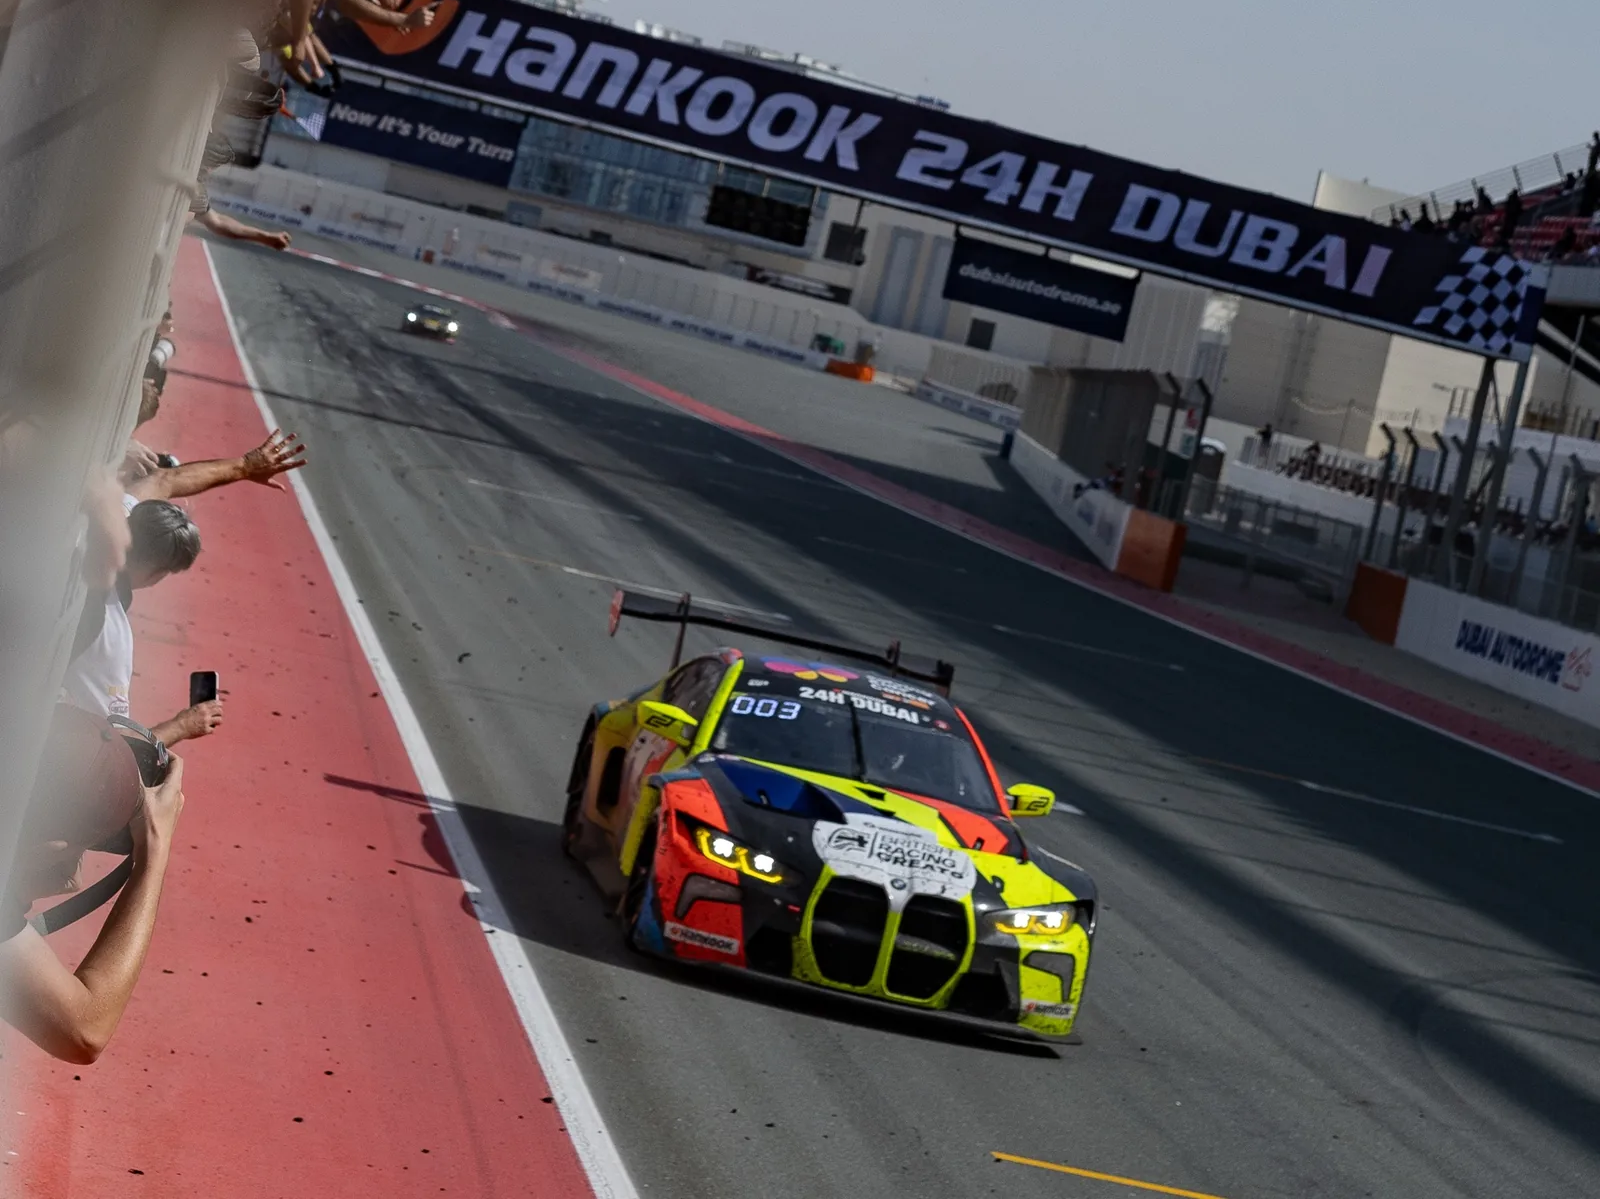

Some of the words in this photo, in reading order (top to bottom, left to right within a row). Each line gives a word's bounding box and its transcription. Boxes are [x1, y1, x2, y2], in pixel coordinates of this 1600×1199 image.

[328, 102, 378, 128] Now
[377, 114, 413, 138] It's
[415, 122, 465, 149] Your
[466, 136, 516, 163] Turn
[895, 130, 1095, 221] 24H
[1110, 182, 1393, 297] DUBAI
[958, 262, 1122, 316] dubaiautodrome.ae
[1455, 619, 1494, 658] DUBAI
[1488, 630, 1566, 685] AUTODROME
[731, 695, 801, 720] 003
[799, 685, 845, 706] 24H
[850, 697, 920, 725] DUBAI
[878, 843, 956, 869] RACING
